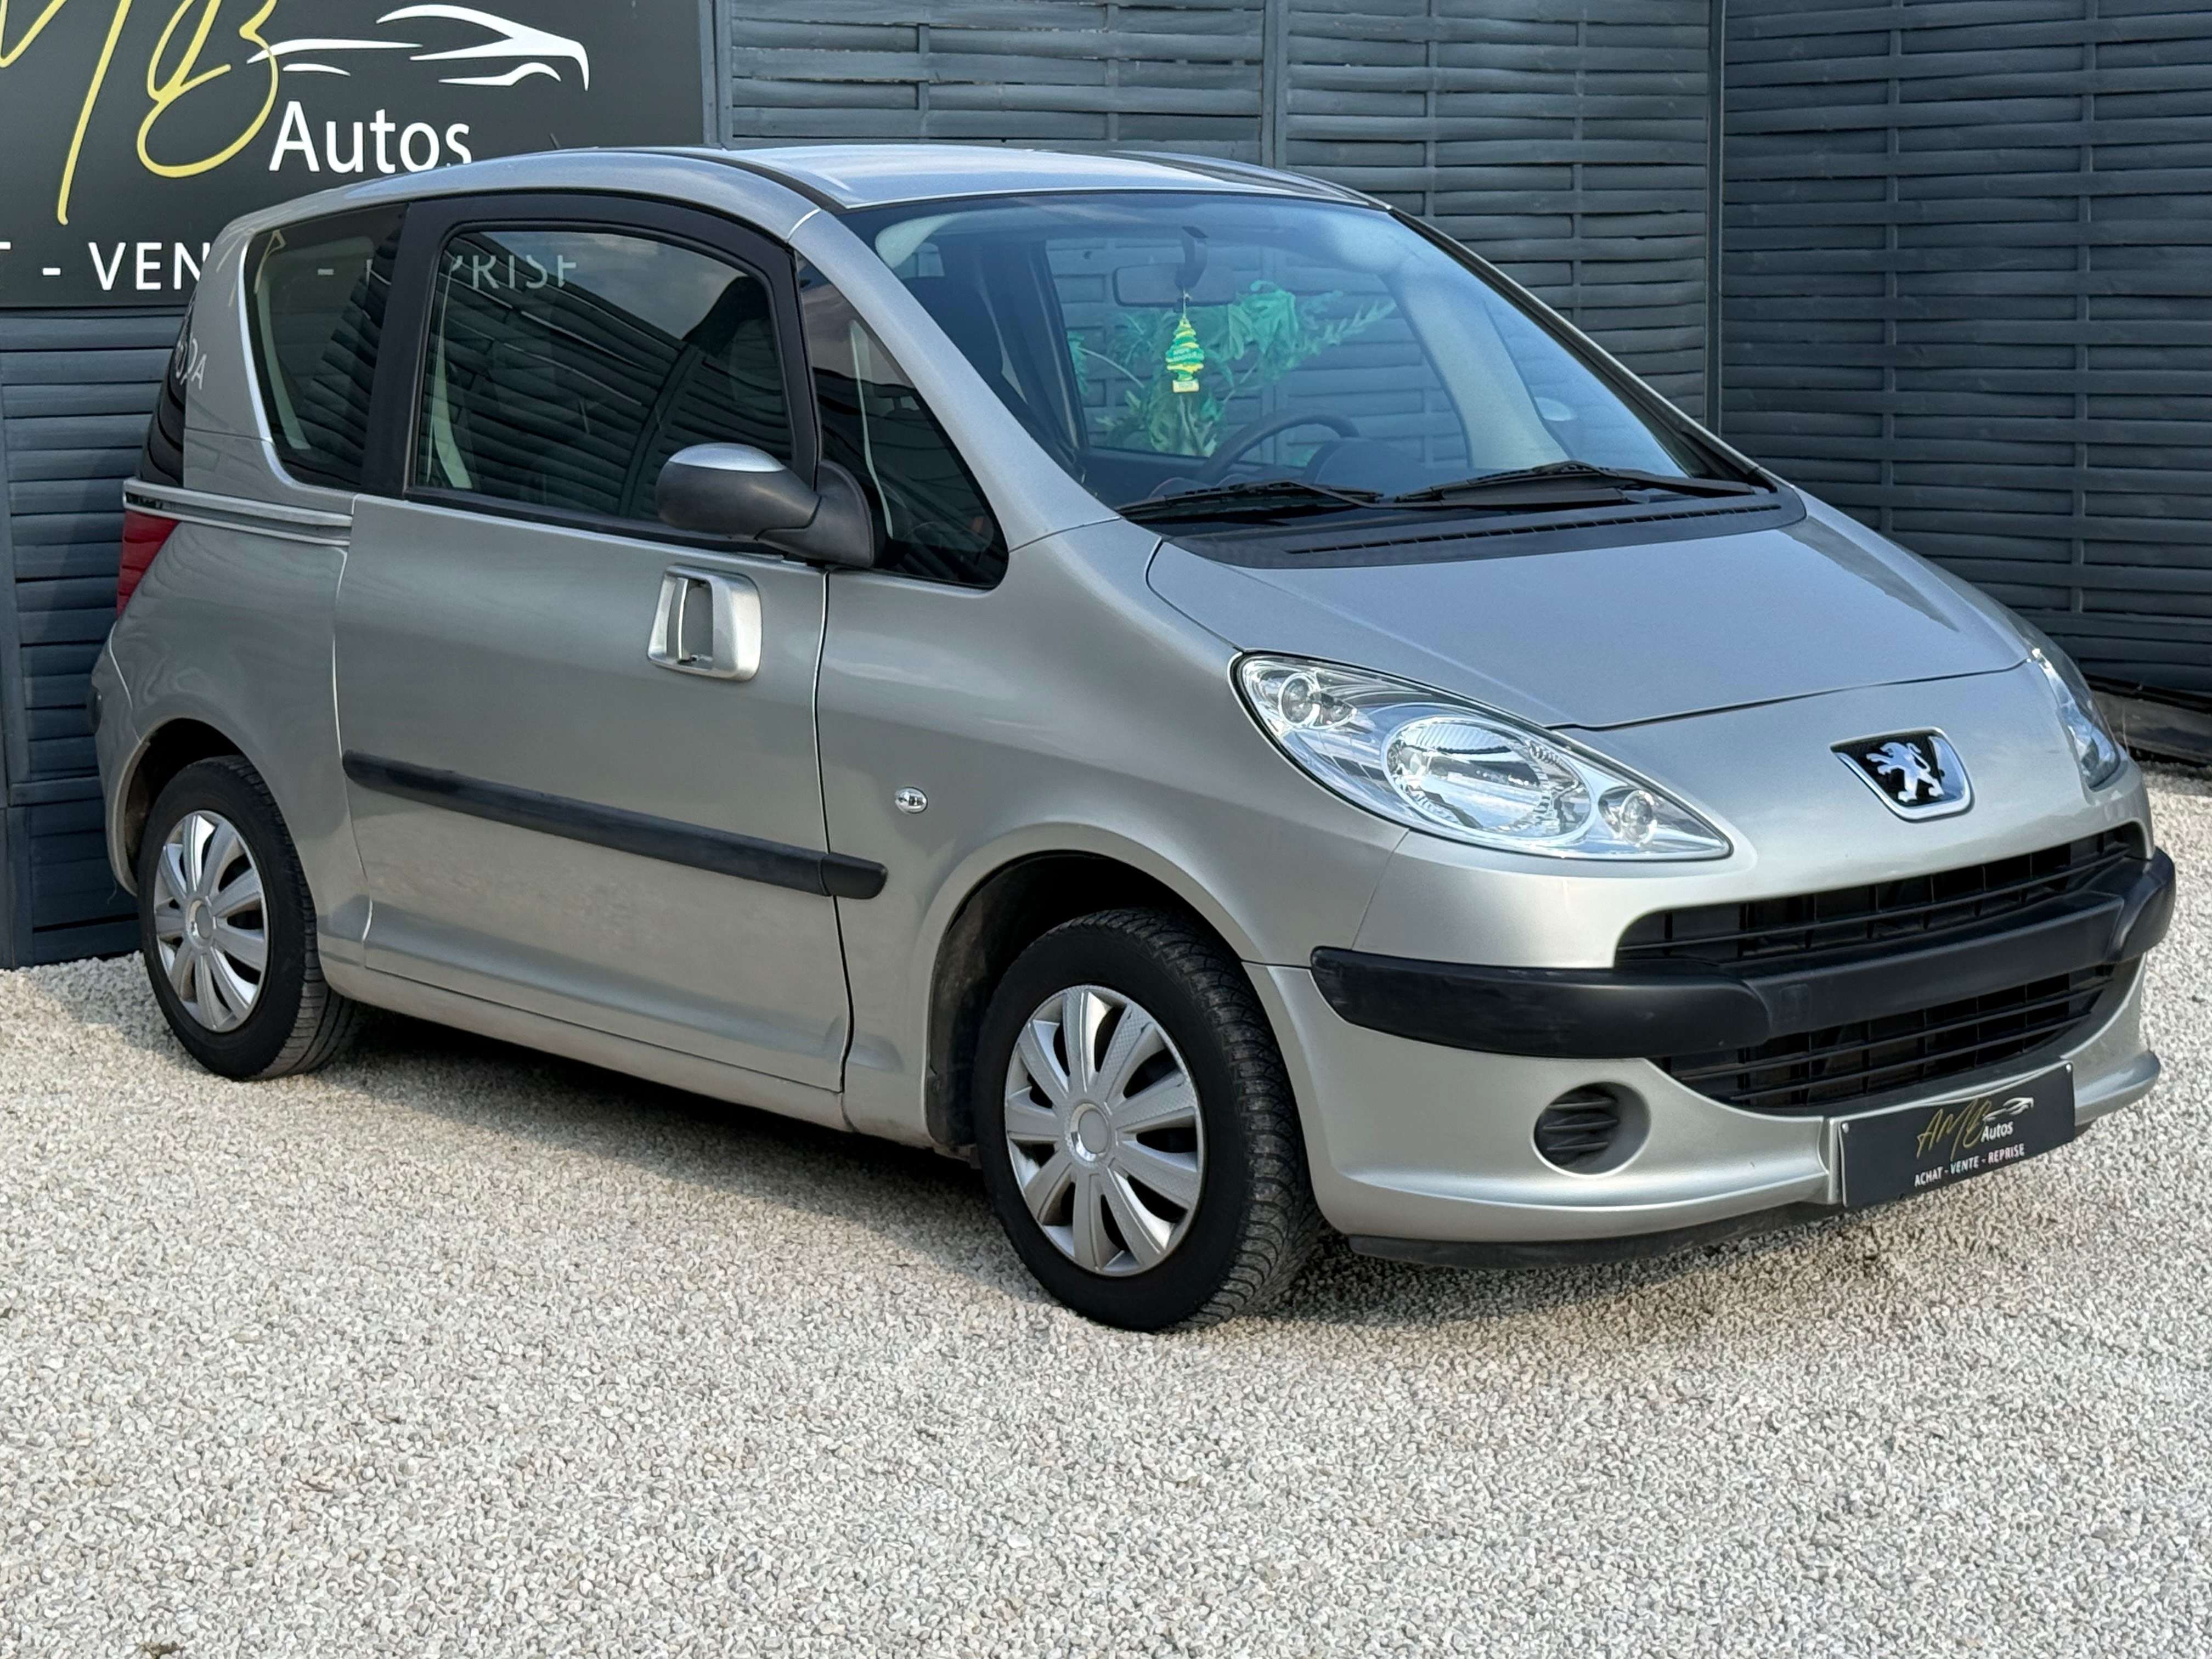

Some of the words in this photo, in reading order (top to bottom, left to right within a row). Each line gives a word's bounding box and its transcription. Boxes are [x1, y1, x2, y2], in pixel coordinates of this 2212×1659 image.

[269, 101, 472, 173] Autos
[1980, 1121, 2013, 1143] Autos
[1914, 1166, 1943, 1188] ACHAT
[1950, 1155, 1980, 1175] VENTE
[1988, 1143, 2024, 1165] REPRISE
